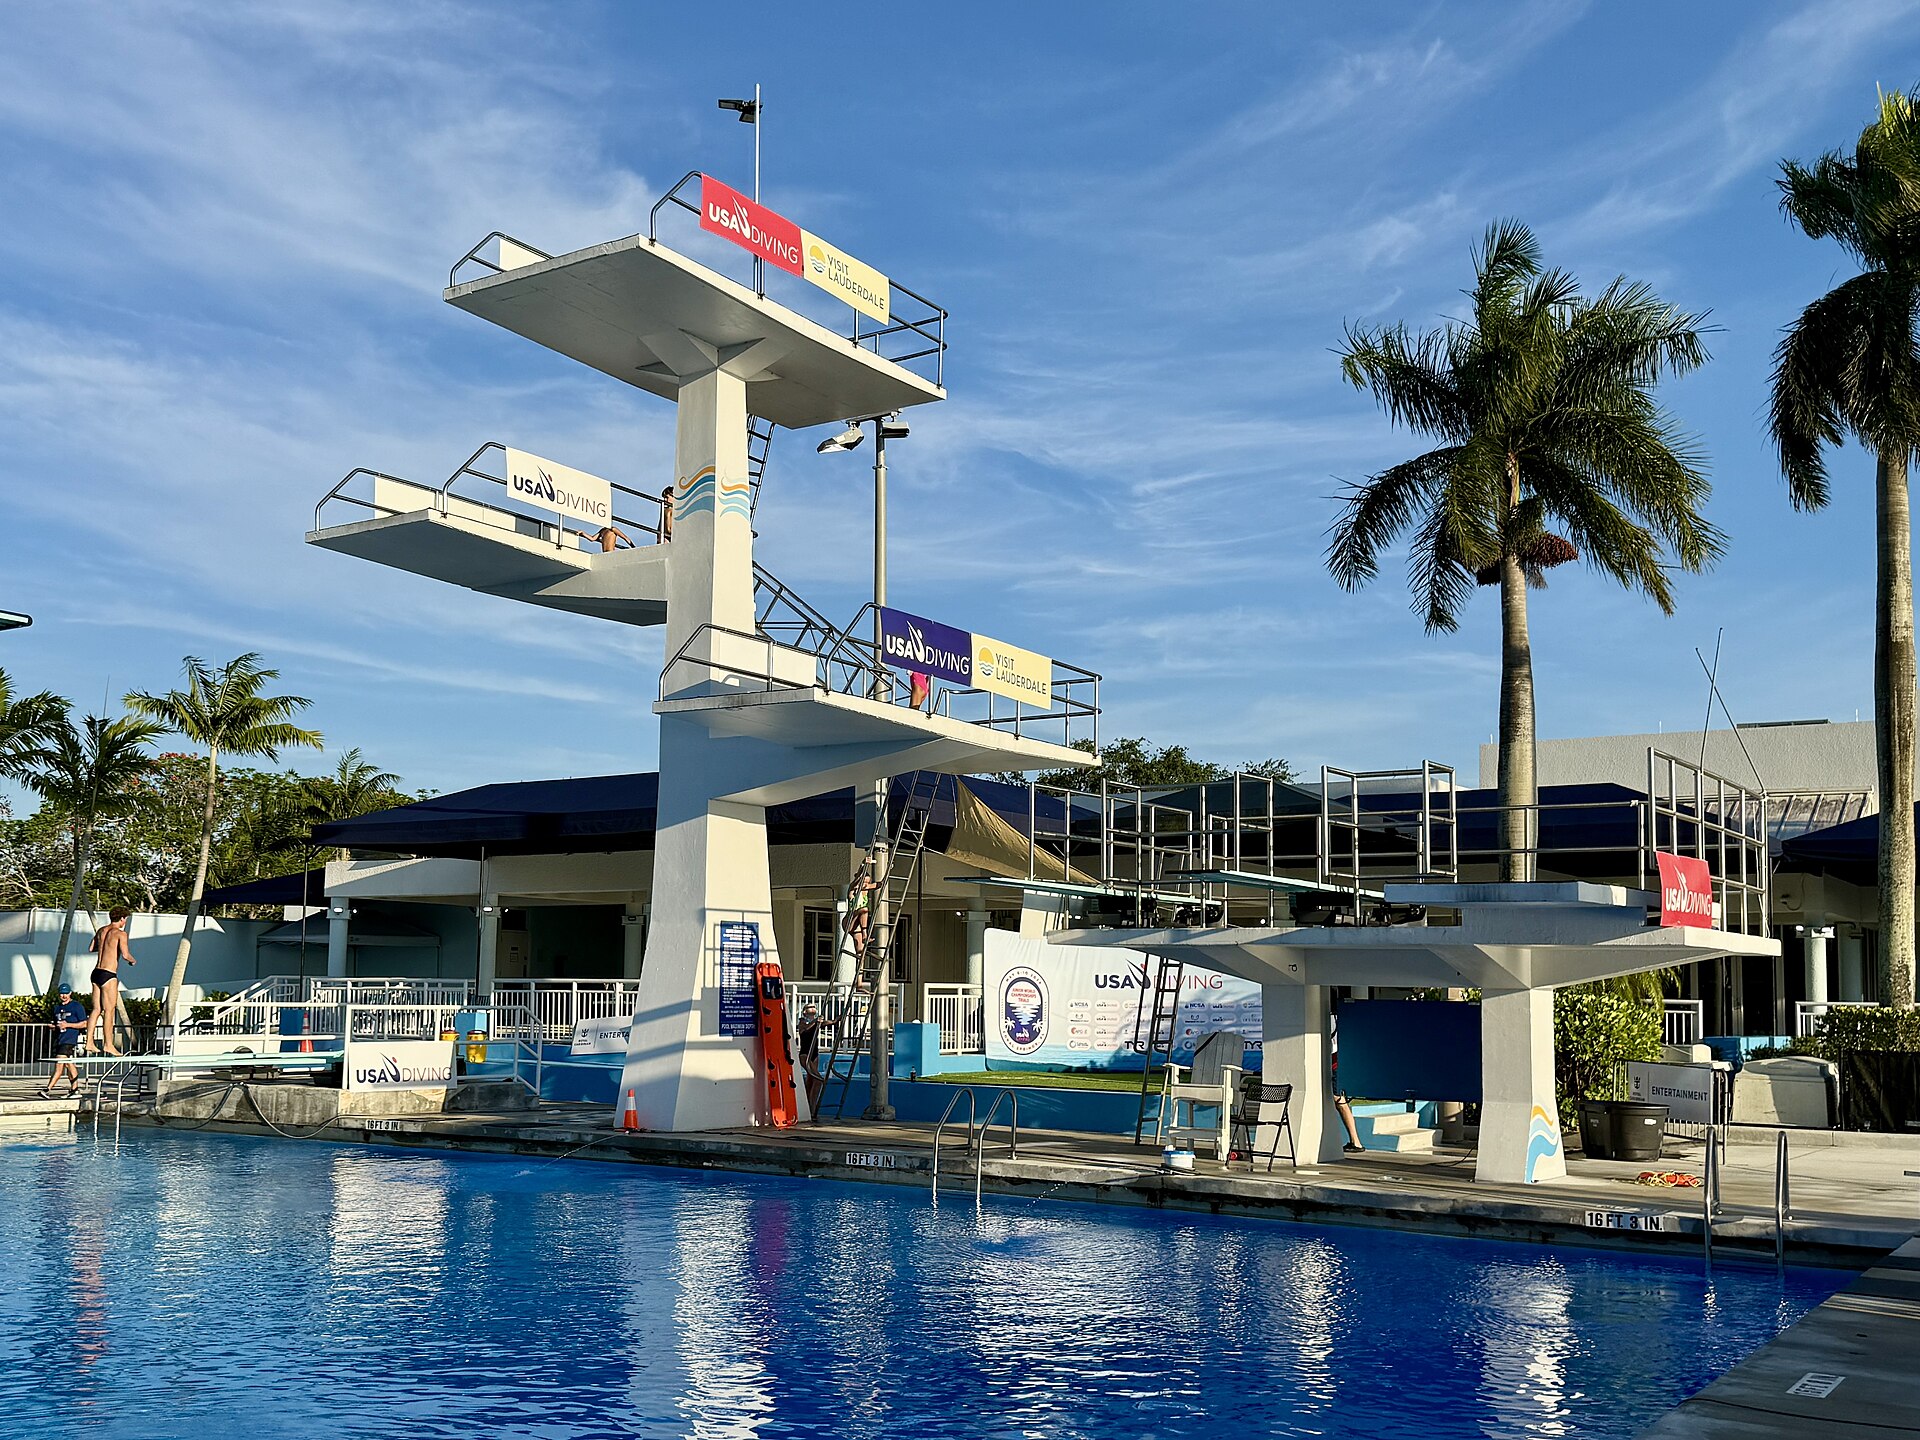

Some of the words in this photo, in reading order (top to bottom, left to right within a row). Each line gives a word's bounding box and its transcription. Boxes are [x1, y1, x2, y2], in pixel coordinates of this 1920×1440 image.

[708, 202, 741, 232] USA
[751, 227, 799, 264] DIVING
[827, 254, 849, 276] VISIT
[828, 267, 885, 310] LAUDERDALE
[513, 474, 544, 499] USA
[556, 489, 607, 518] DIVING
[886, 634, 914, 660] USA
[925, 645, 970, 675] DIVING
[995, 653, 1015, 671] VISIT
[996, 668, 1047, 695] LAUDERDALE
[1665, 887, 1681, 912] USA
[1685, 890, 1711, 917] DIVING
[1094, 974, 1135, 989] USA
[1244, 1041, 1262, 1050] TYR
[356, 1068, 389, 1084] USA
[402, 1066, 452, 1083] DIVING
[1651, 1086, 1708, 1101] ENTERTAINMENT
[385, 1121, 389, 1130] 3
[847, 1153, 858, 1164] 16
[873, 1155, 879, 1166] 3
[1587, 1212, 1603, 1227] 16
[1629, 1215, 1639, 1229] 3
[1644, 1216, 1663, 1231] IN.
